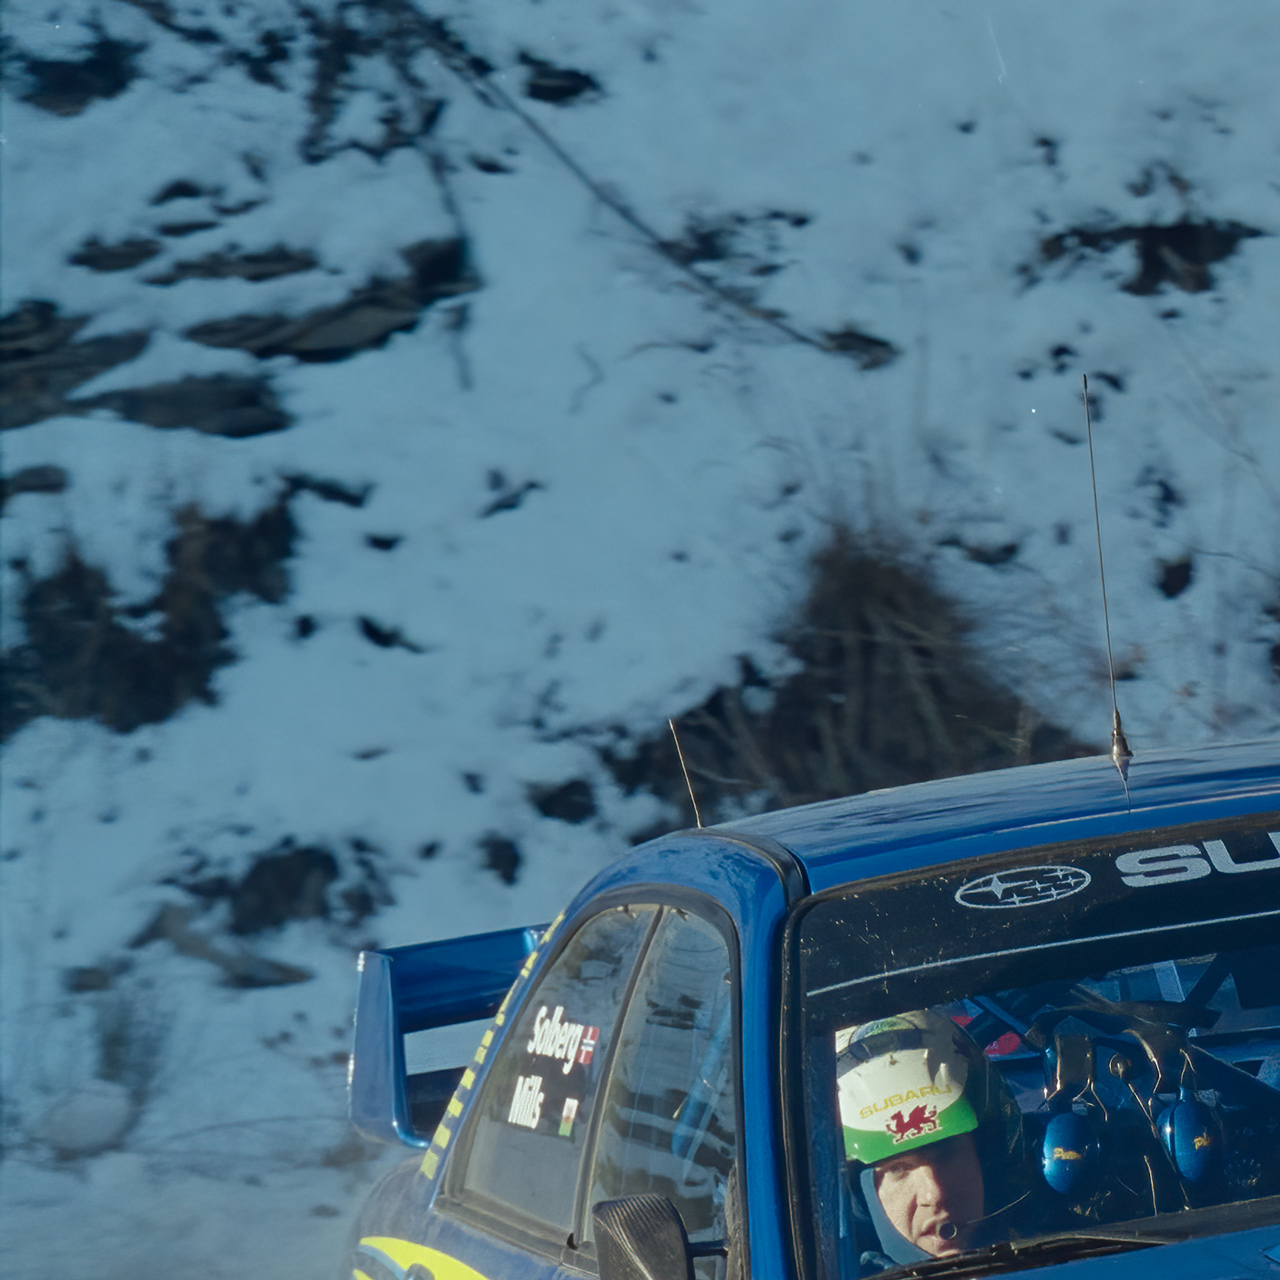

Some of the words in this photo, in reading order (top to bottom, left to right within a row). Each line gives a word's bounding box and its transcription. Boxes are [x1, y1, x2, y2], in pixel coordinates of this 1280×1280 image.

[527, 1005, 584, 1074] Solberg
[508, 1075, 545, 1129] Mills
[860, 1083, 952, 1120] SUBARU
